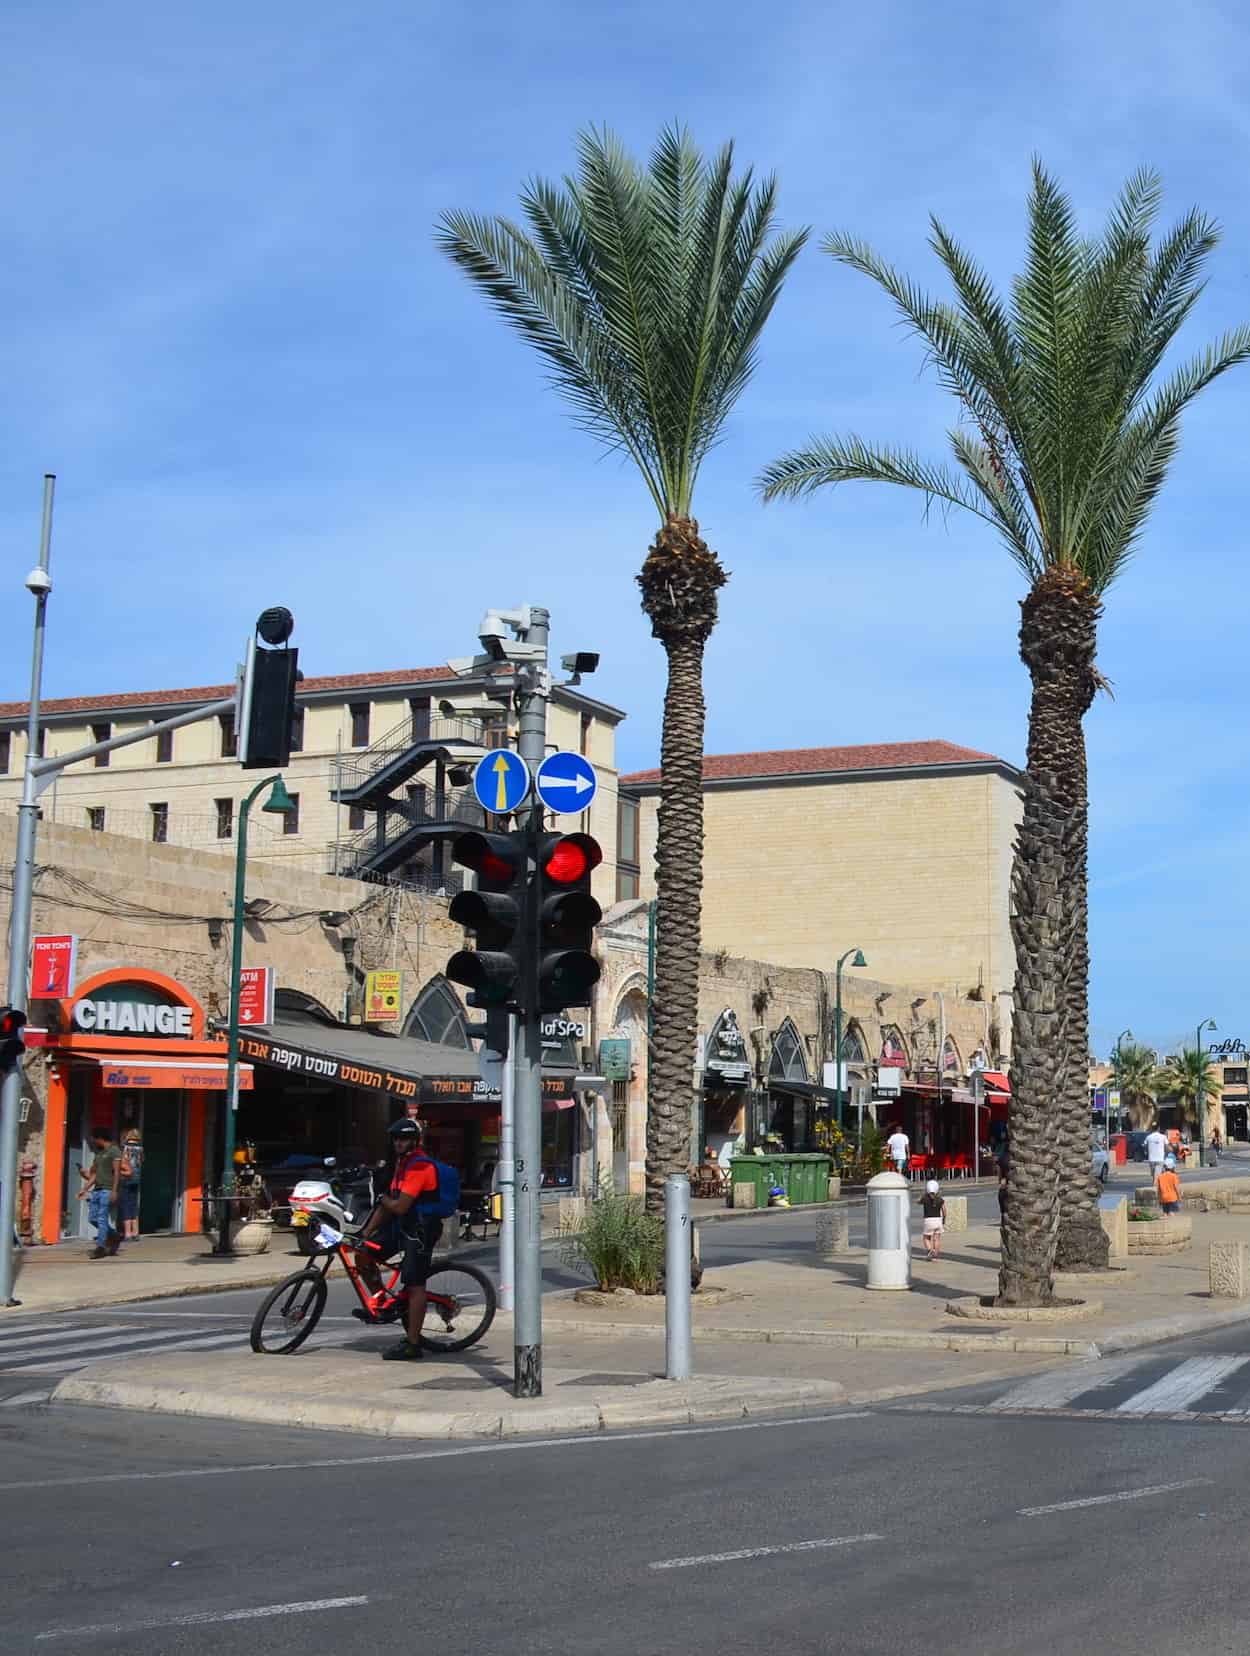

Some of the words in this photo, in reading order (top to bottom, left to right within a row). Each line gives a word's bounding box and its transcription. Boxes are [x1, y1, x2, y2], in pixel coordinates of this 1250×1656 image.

[73, 998, 193, 1035] CHANGE
[304, 1055, 338, 1076] טוסט
[516, 1160, 524, 1173] 3
[521, 1183, 529, 1192] 6
